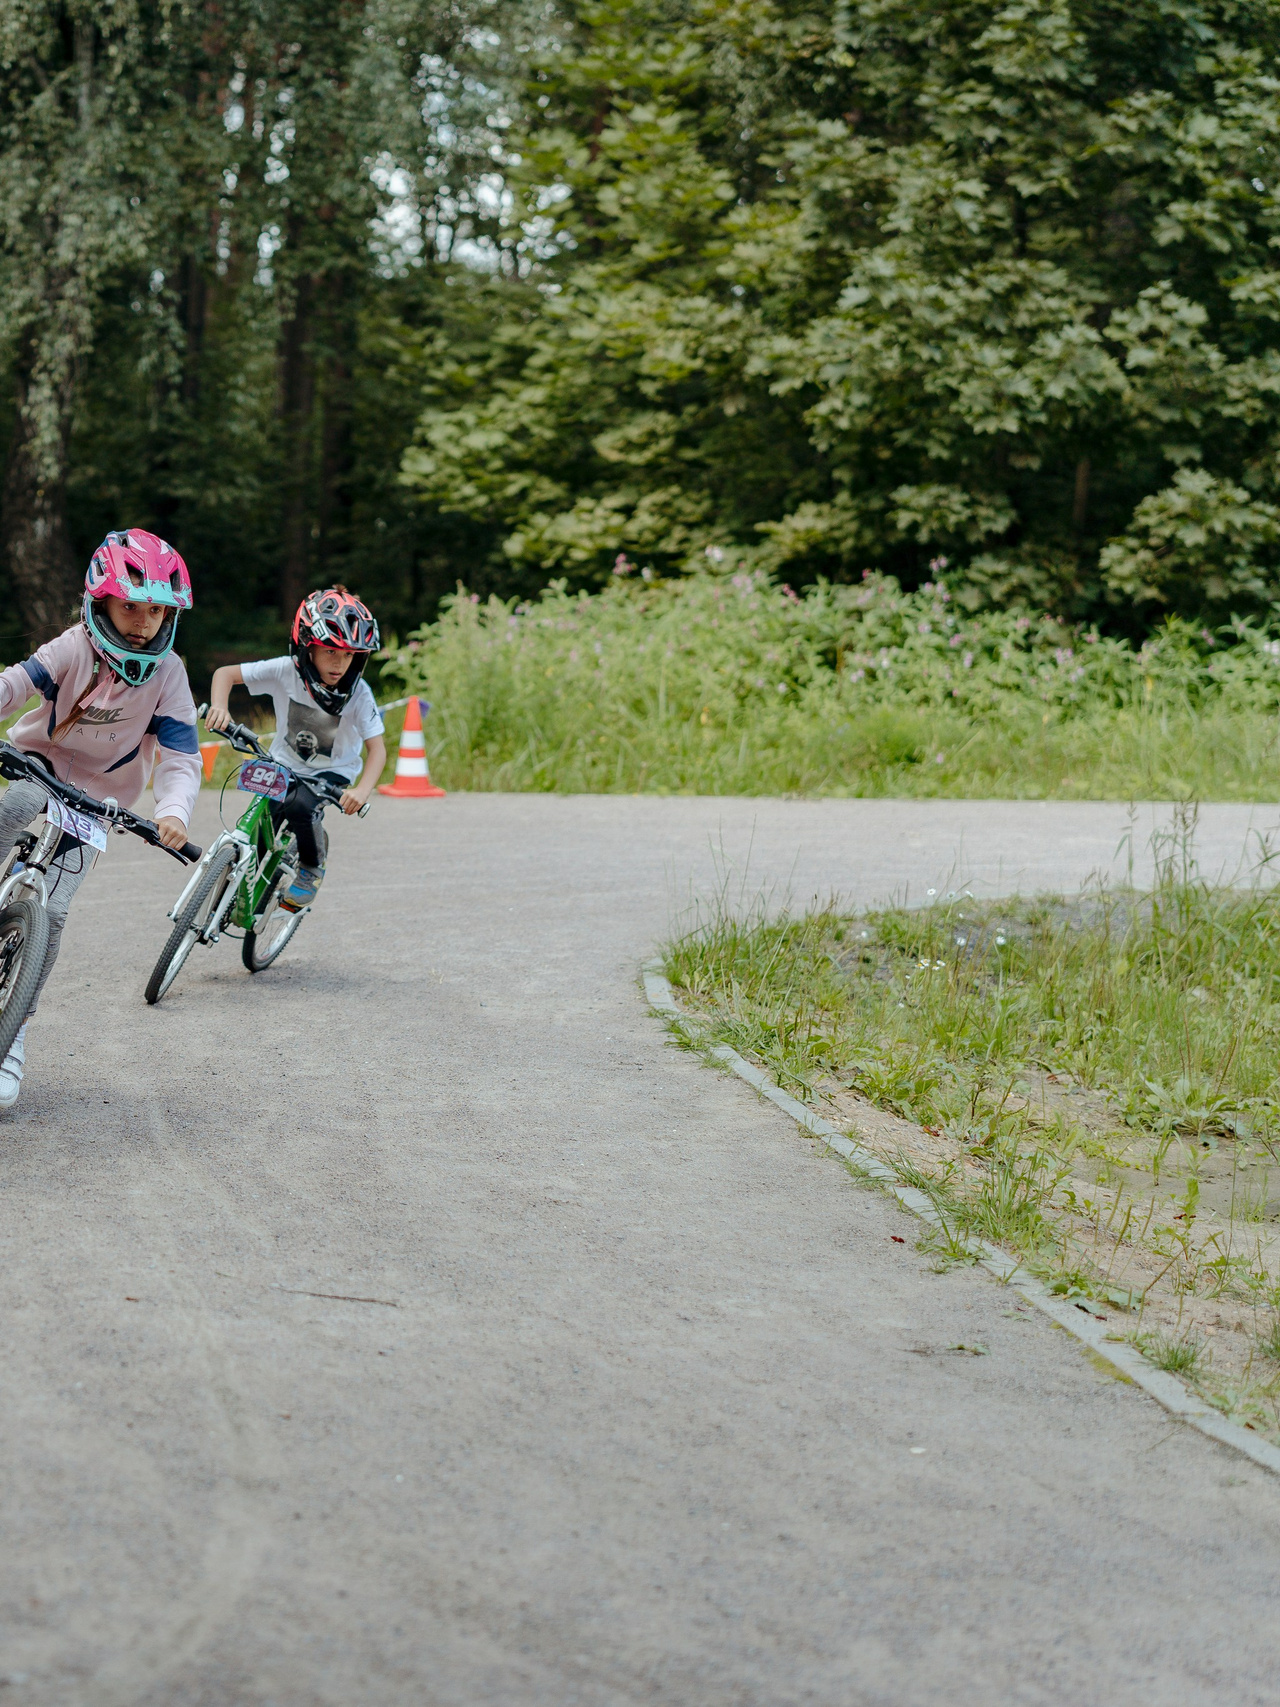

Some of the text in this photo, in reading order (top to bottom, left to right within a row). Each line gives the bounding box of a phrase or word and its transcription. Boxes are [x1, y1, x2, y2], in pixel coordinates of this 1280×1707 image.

[85, 706, 124, 721] NIKE
[76, 728, 117, 742] AIR
[250, 767, 276, 786] 94
